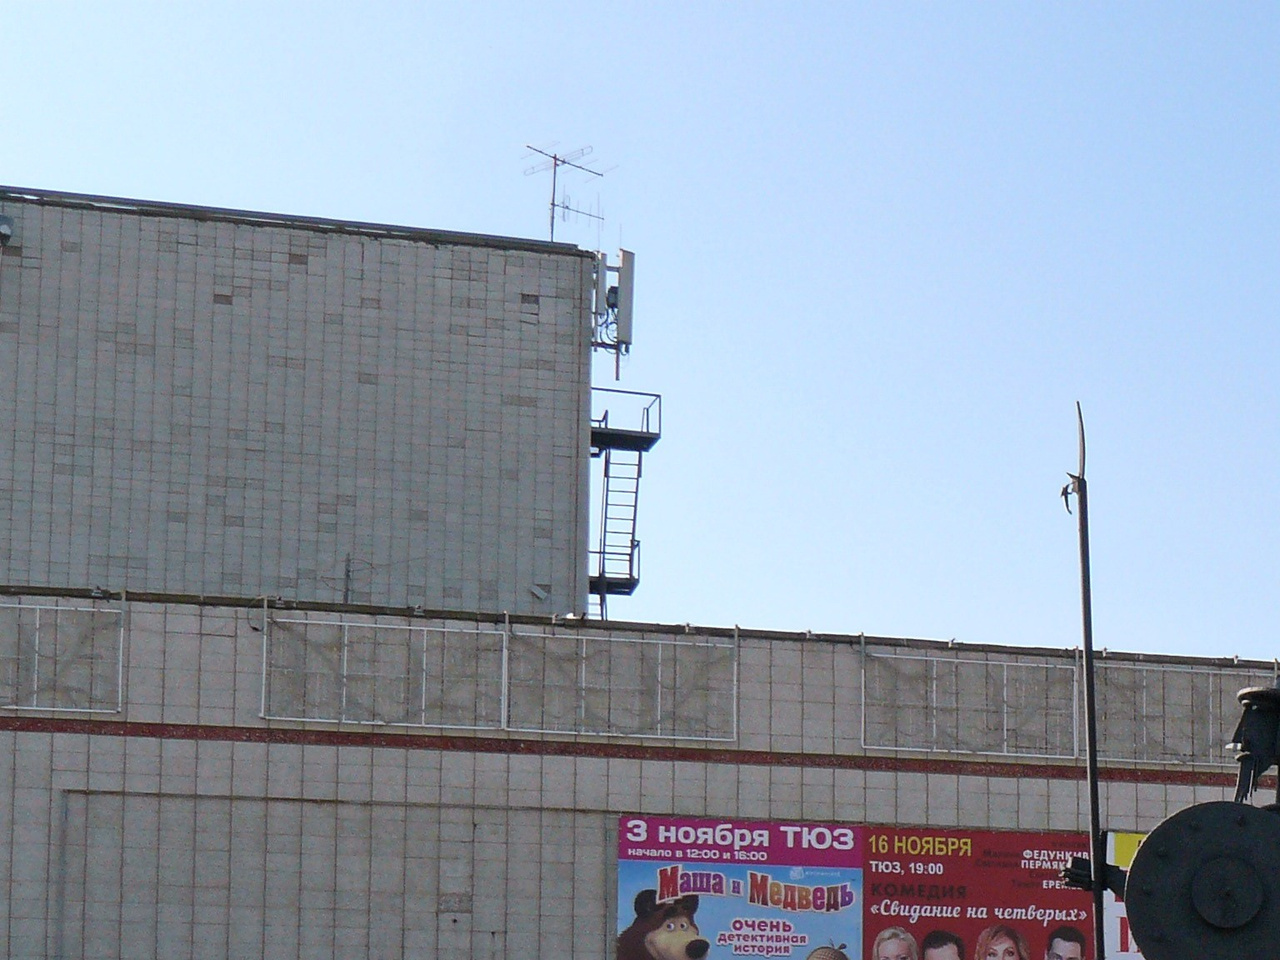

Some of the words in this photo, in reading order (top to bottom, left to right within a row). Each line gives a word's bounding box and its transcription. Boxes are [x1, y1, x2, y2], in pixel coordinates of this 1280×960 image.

[627, 820, 647, 841] 3
[659, 824, 769, 850] ноября
[780, 826, 854, 850] ТЮЗ
[869, 835, 888, 854] 16
[894, 836, 972, 856] НОЯБРЯ
[628, 848, 671, 858] начало
[676, 850, 682, 858] в
[686, 849, 719, 859] 12:00
[870, 861, 905, 875] ТЮЗ,
[909, 863, 943, 875] 19:00
[657, 865, 724, 902] Маша
[749, 873, 854, 912] Медведь
[871, 883, 967, 900] КОМЕДИЯ
[967, 908, 987, 918] на
[732, 918, 792, 932] очень
[718, 932, 806, 944] детективная
[734, 943, 790, 955] история
